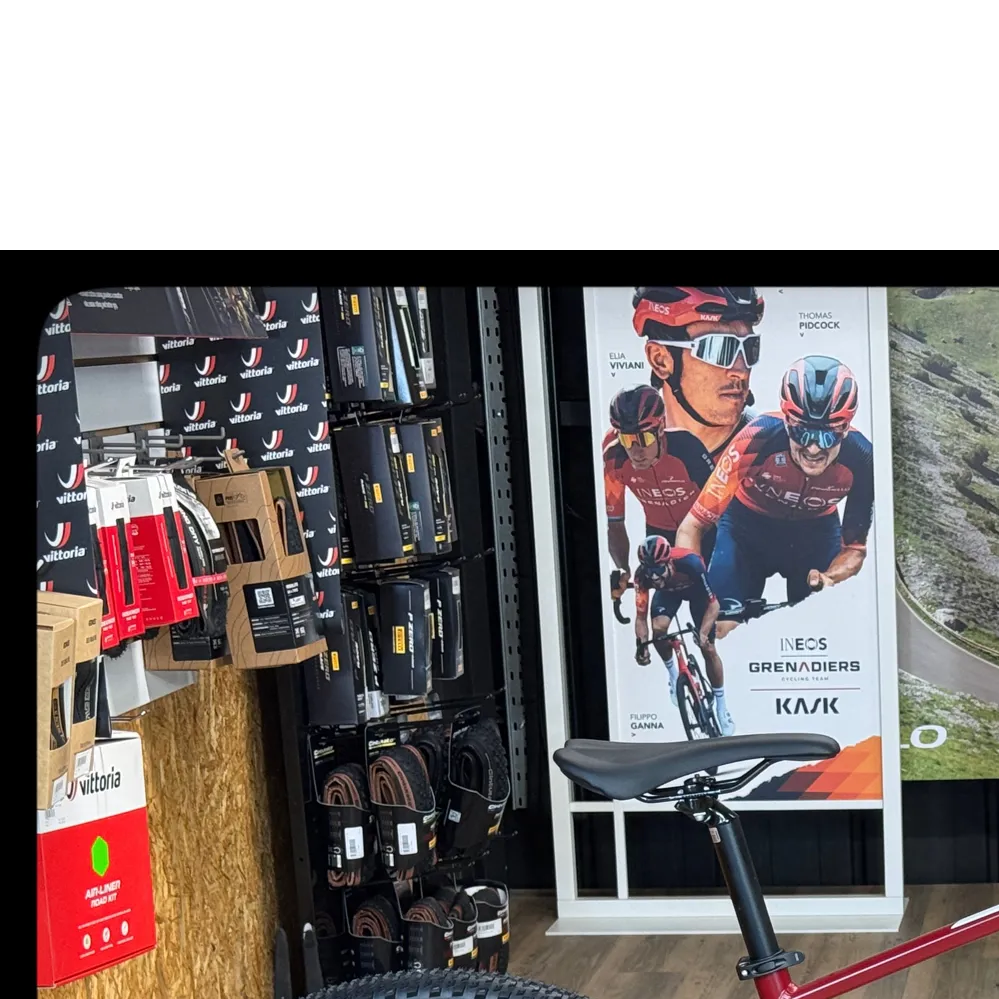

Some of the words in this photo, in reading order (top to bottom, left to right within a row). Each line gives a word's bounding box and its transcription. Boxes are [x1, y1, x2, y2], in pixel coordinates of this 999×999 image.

[648, 304, 671, 315] INEOS
[799, 312, 833, 320] THOMAS
[300, 314, 320, 325] vitto
[799, 321, 840, 330] PIDCOCK
[45, 322, 71, 336] vitto
[609, 352, 626, 360] ELIA
[286, 357, 320, 371] vittoria
[610, 361, 645, 370] VIVIANI
[240, 366, 273, 379] vittoria
[37, 380, 70, 395] ttoria
[194, 375, 227, 388] vittoria
[161, 383, 181, 394] toria
[275, 403, 308, 416] vittoria
[229, 411, 262, 425] vittoria
[184, 420, 216, 433] vittoria
[261, 450, 294, 462] vittoria
[706, 446, 741, 499] INEOS
[57, 491, 87, 505] vittor
[296, 485, 330, 498] vittoria
[637, 487, 686, 498] INEOS
[43, 546, 86, 563] vittoria
[780, 637, 827, 651] INEOS
[749, 660, 860, 673] GRENADIERS
[776, 697, 840, 716] KASK
[630, 713, 657, 721] FILIPPO
[631, 722, 664, 730] GANNA
[79, 766, 121, 796] vittoria
[85, 880, 121, 900] AIR-LINER
